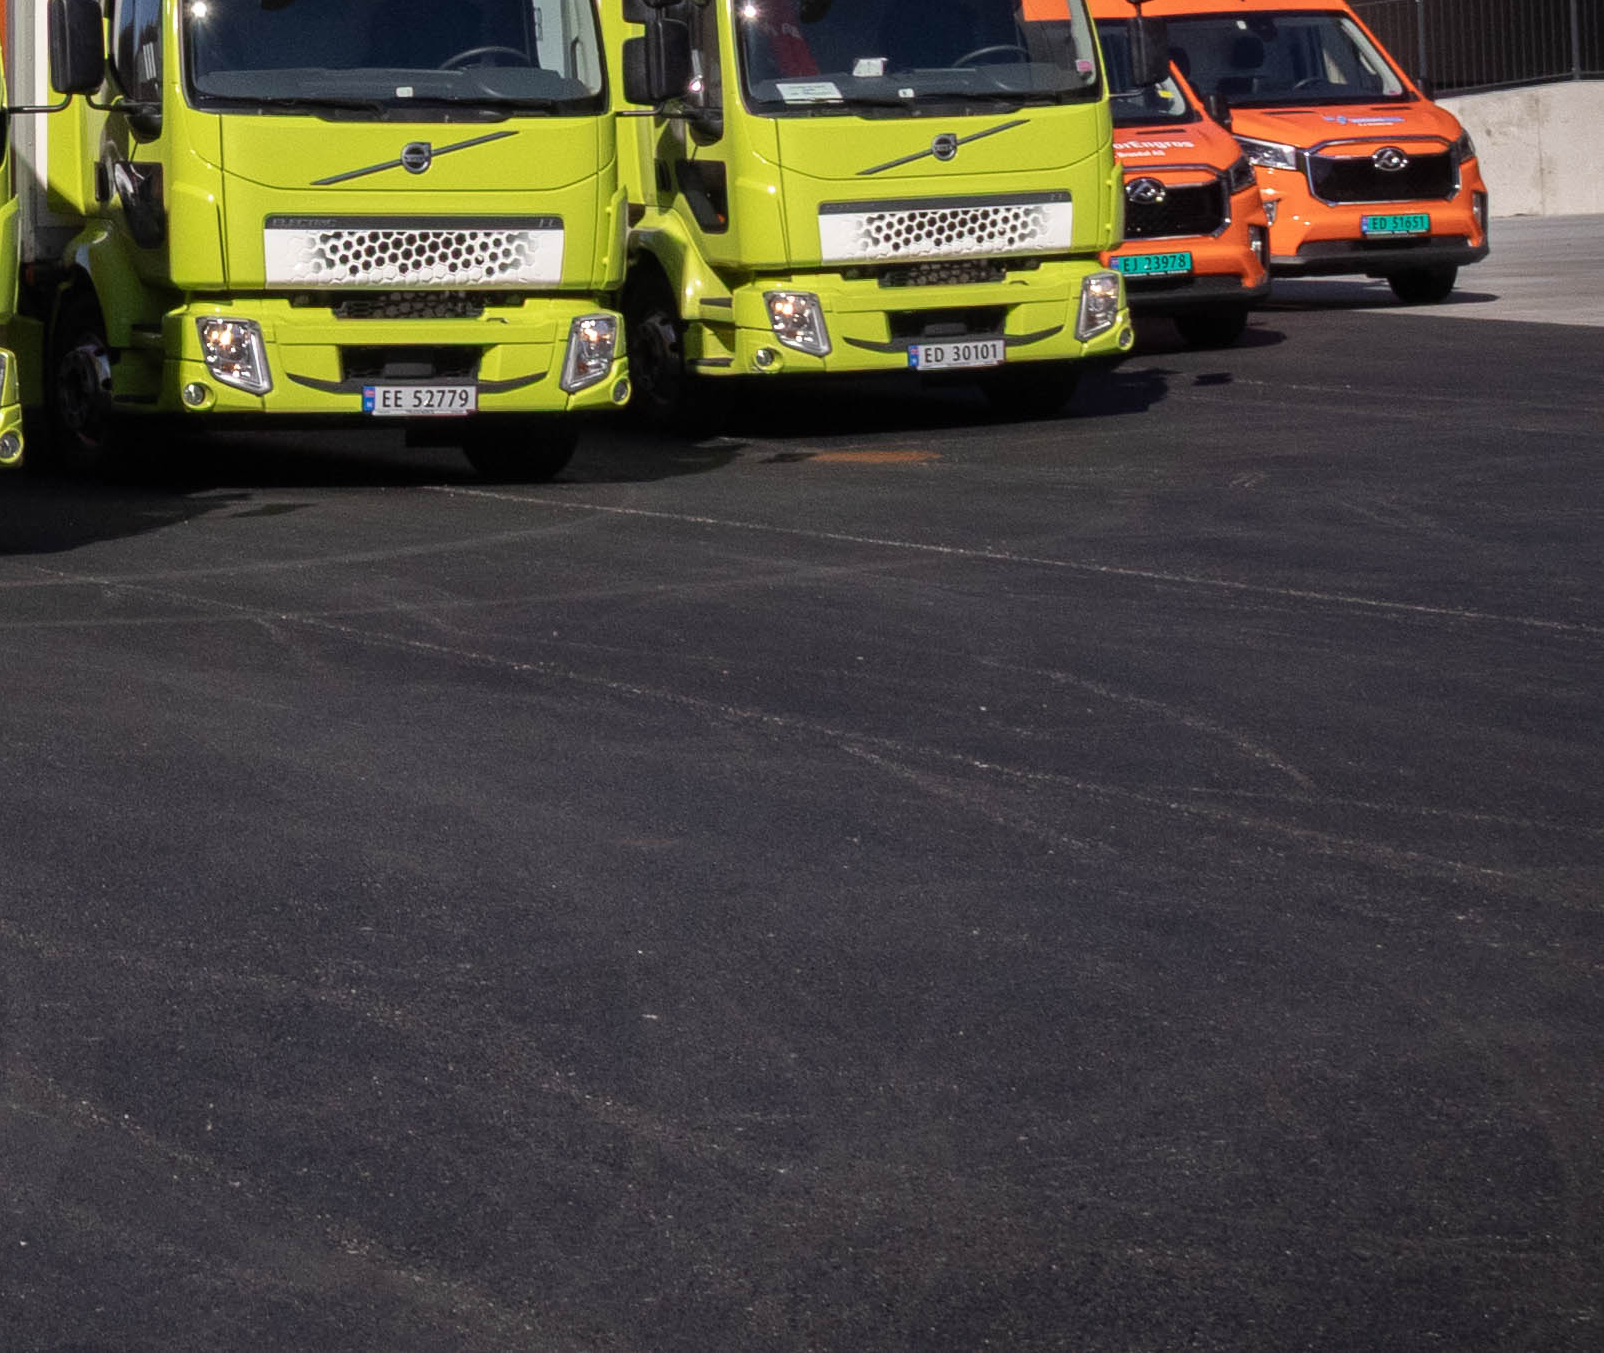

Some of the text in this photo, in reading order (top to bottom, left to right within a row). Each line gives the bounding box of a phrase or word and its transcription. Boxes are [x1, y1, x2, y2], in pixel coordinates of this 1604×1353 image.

[1373, 217, 1387, 229] ED
[1123, 254, 1186, 271] EJ 23978
[925, 344, 997, 363] ED 30101
[382, 390, 469, 407] EE 52779
